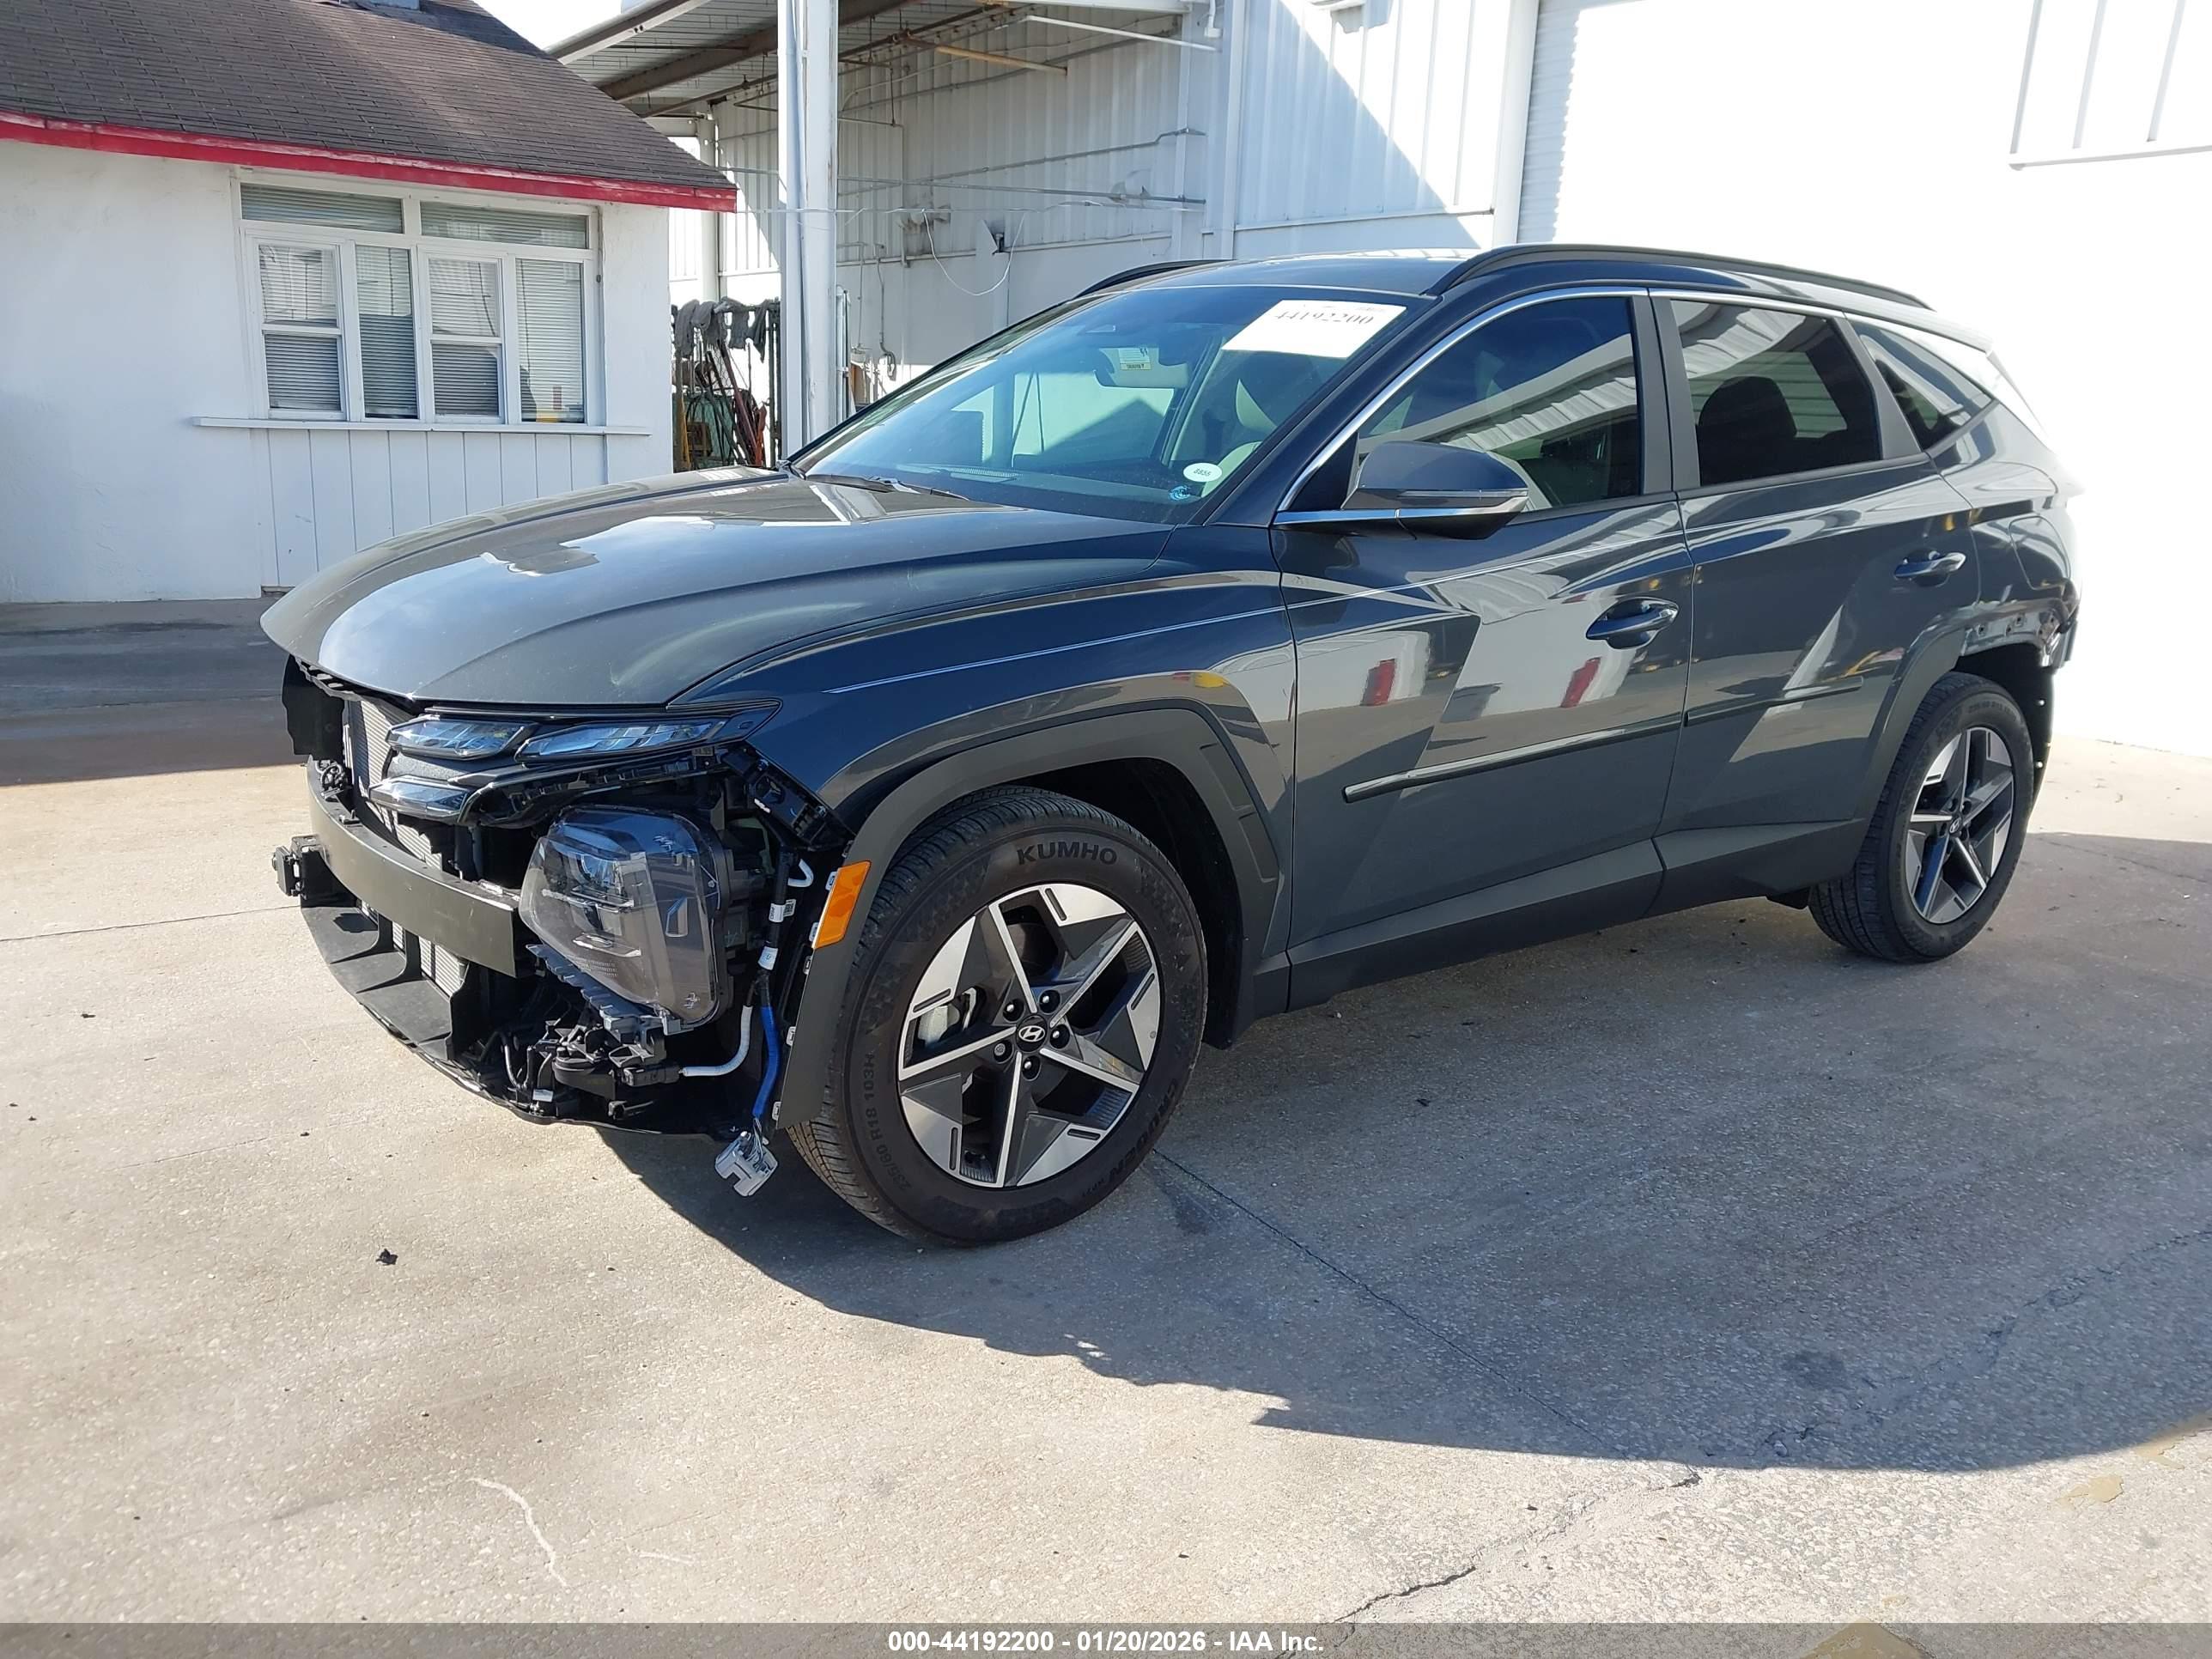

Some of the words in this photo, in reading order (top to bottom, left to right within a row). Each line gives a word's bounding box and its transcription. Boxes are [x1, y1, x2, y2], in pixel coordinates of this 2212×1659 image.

[1274, 311, 1375, 325] 44192200
[1017, 841, 1118, 865] KUMHO
[863, 1054, 876, 1101] 103H
[866, 1107, 884, 1141] R18
